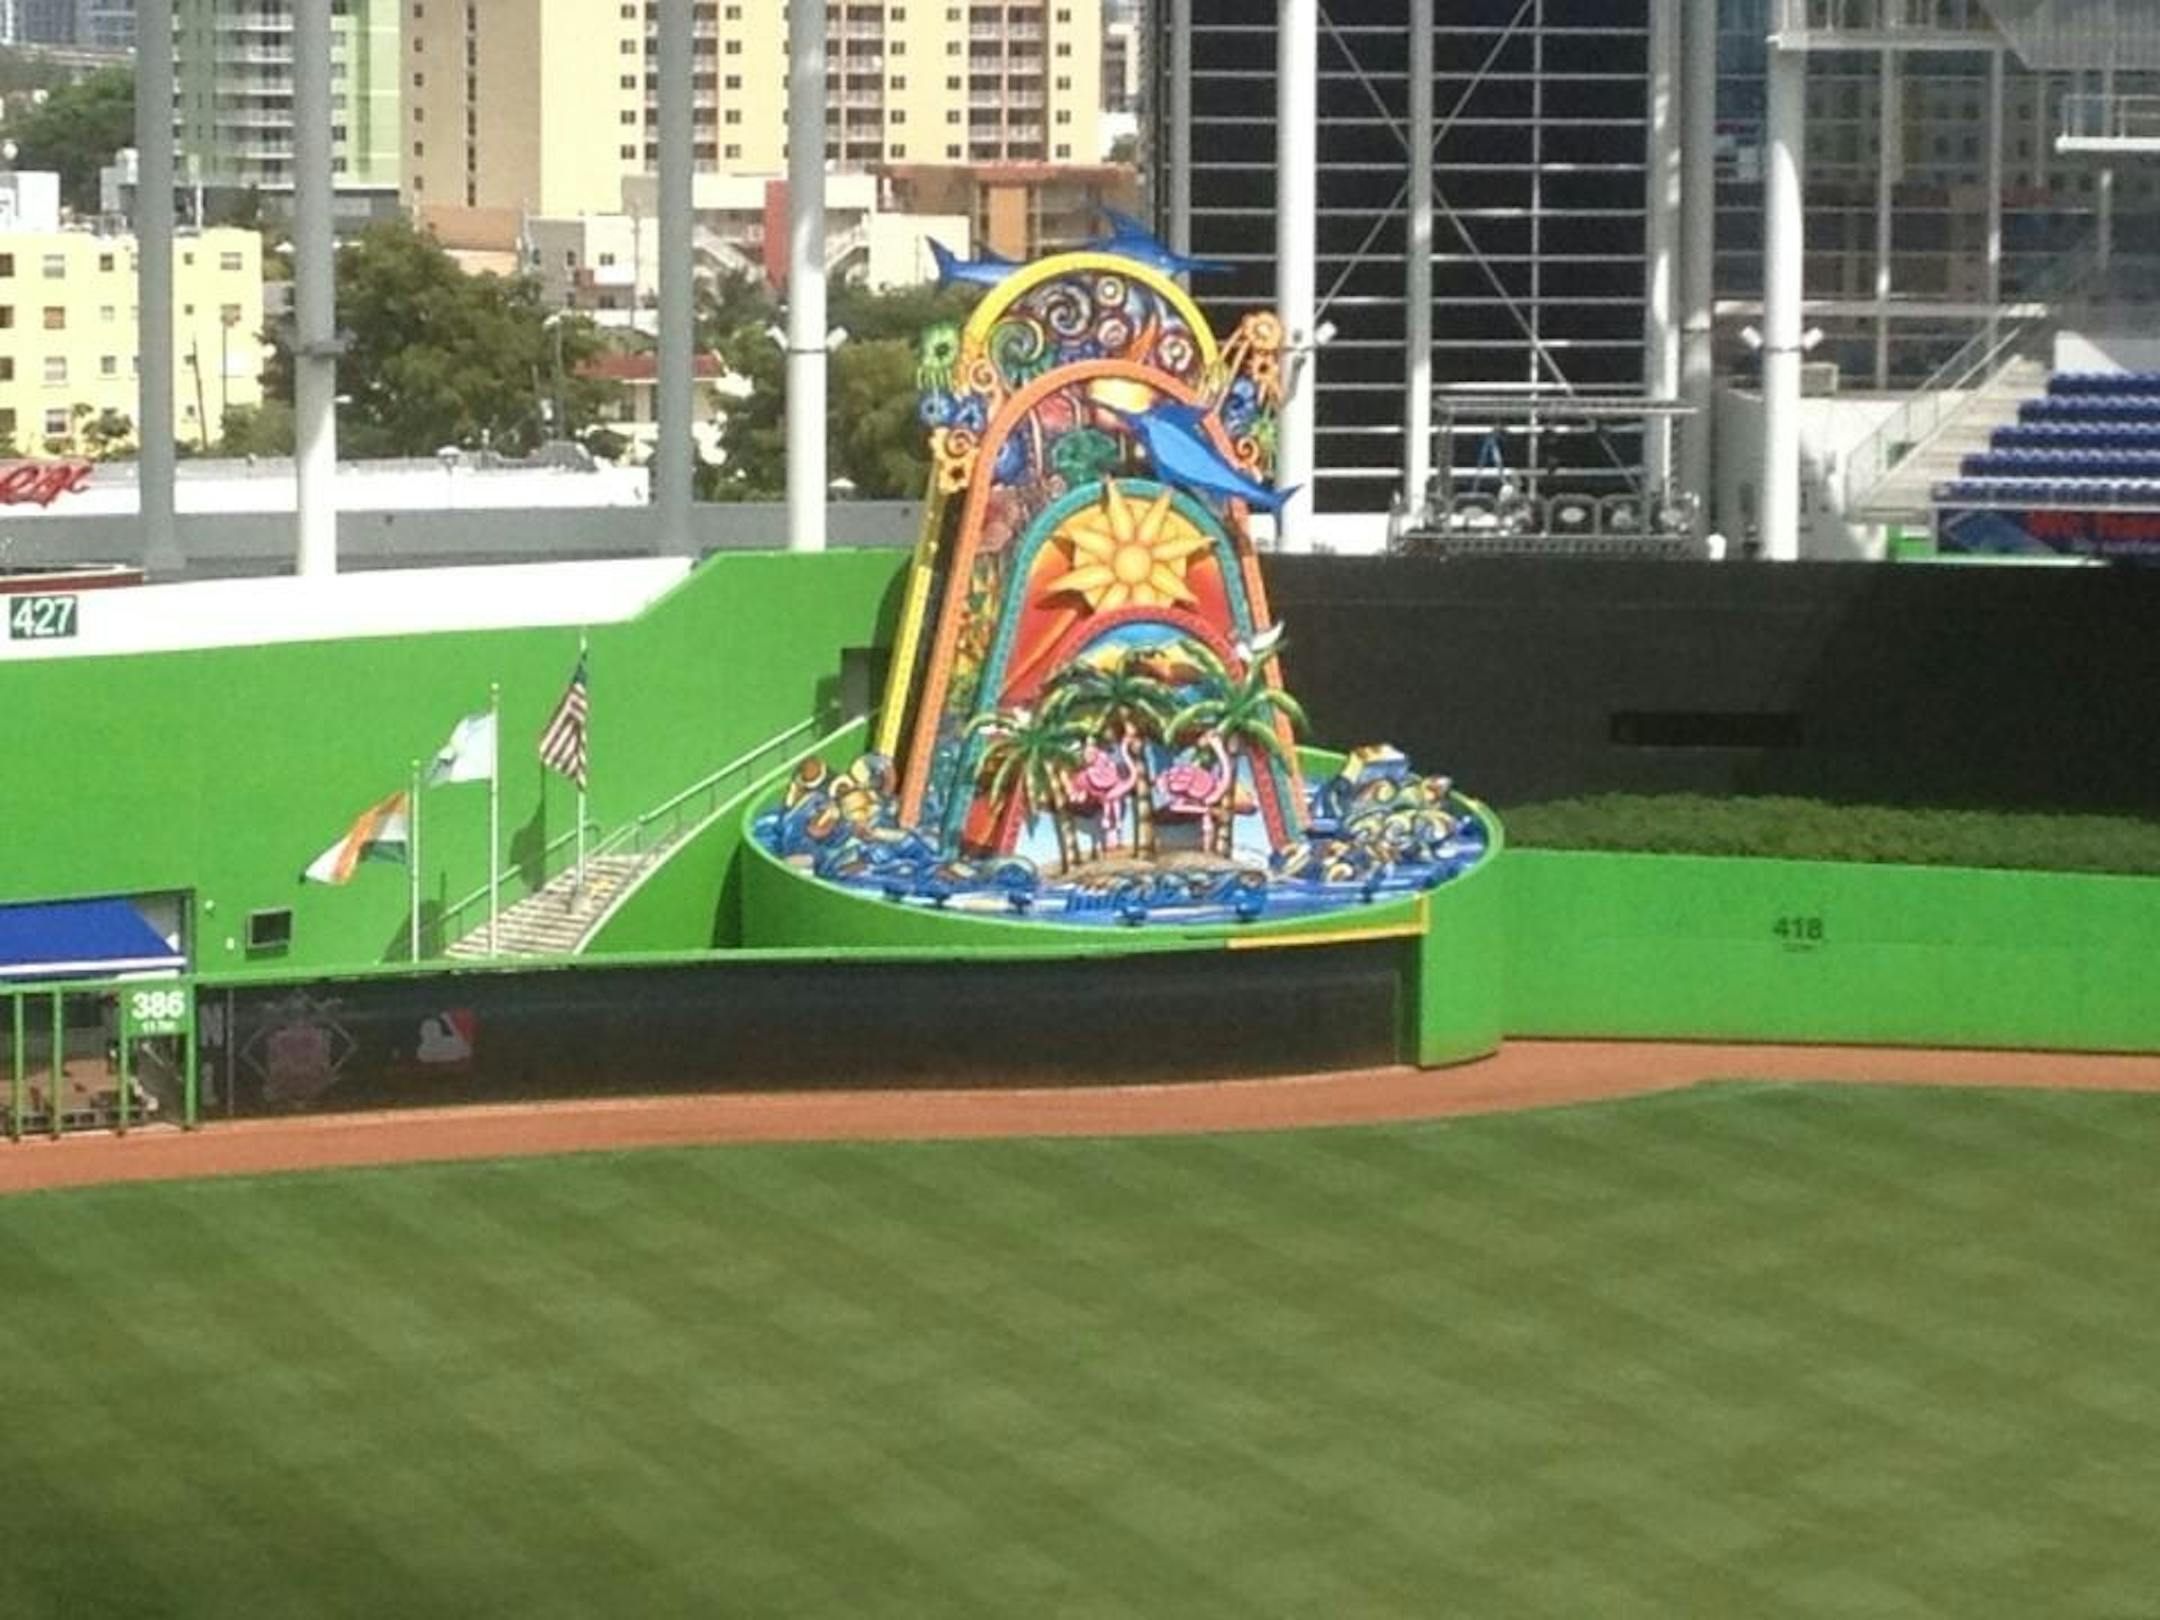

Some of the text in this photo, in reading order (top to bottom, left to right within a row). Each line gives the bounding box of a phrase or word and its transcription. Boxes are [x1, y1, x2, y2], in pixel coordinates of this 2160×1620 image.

[13, 597, 74, 636] 427
[1773, 916, 1823, 940] 418
[131, 990, 185, 1019] 386
